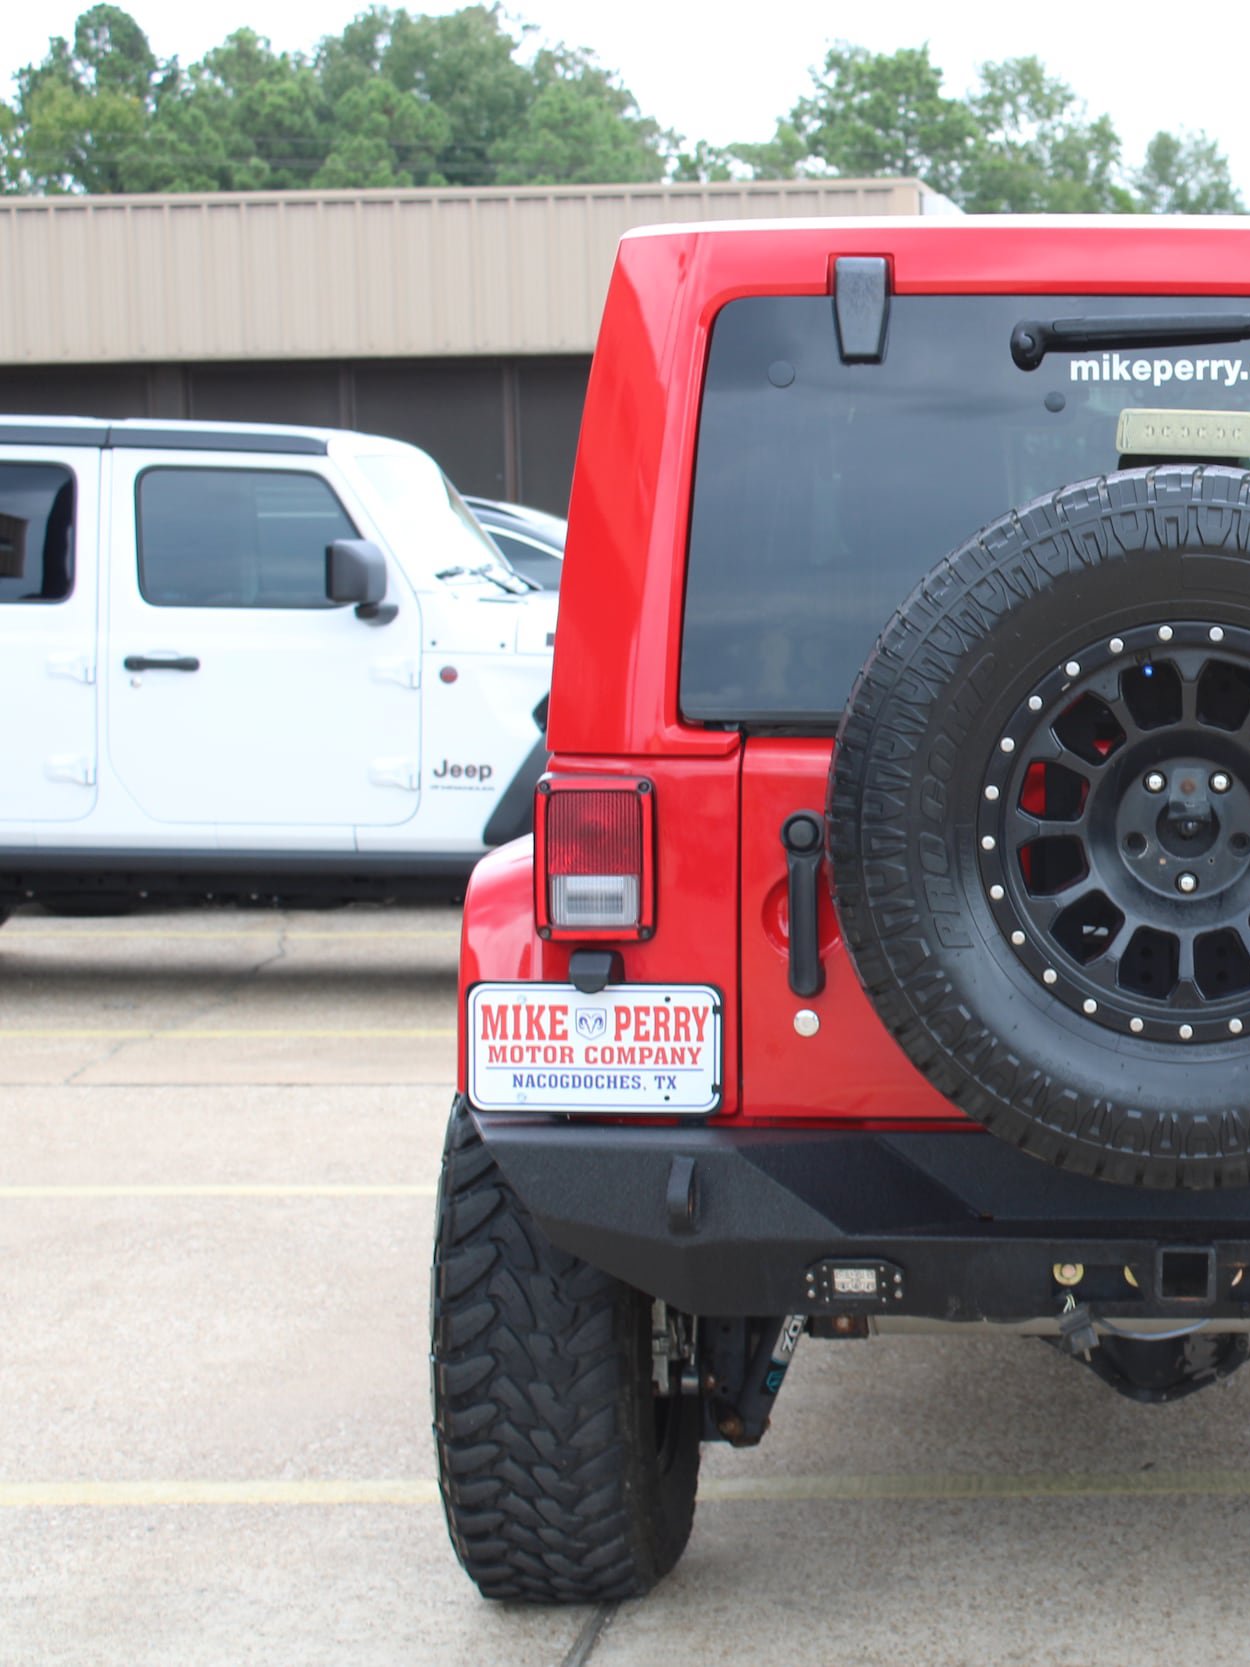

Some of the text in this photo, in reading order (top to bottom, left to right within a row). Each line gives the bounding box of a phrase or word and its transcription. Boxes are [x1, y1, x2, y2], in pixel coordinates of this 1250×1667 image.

[433, 759, 493, 783] Jeep
[480, 1004, 710, 1043] MIKE PERRY
[488, 1045, 702, 1065] MOTOR COMPANY
[512, 1073, 677, 1091] NACOGDOCHES, TX
